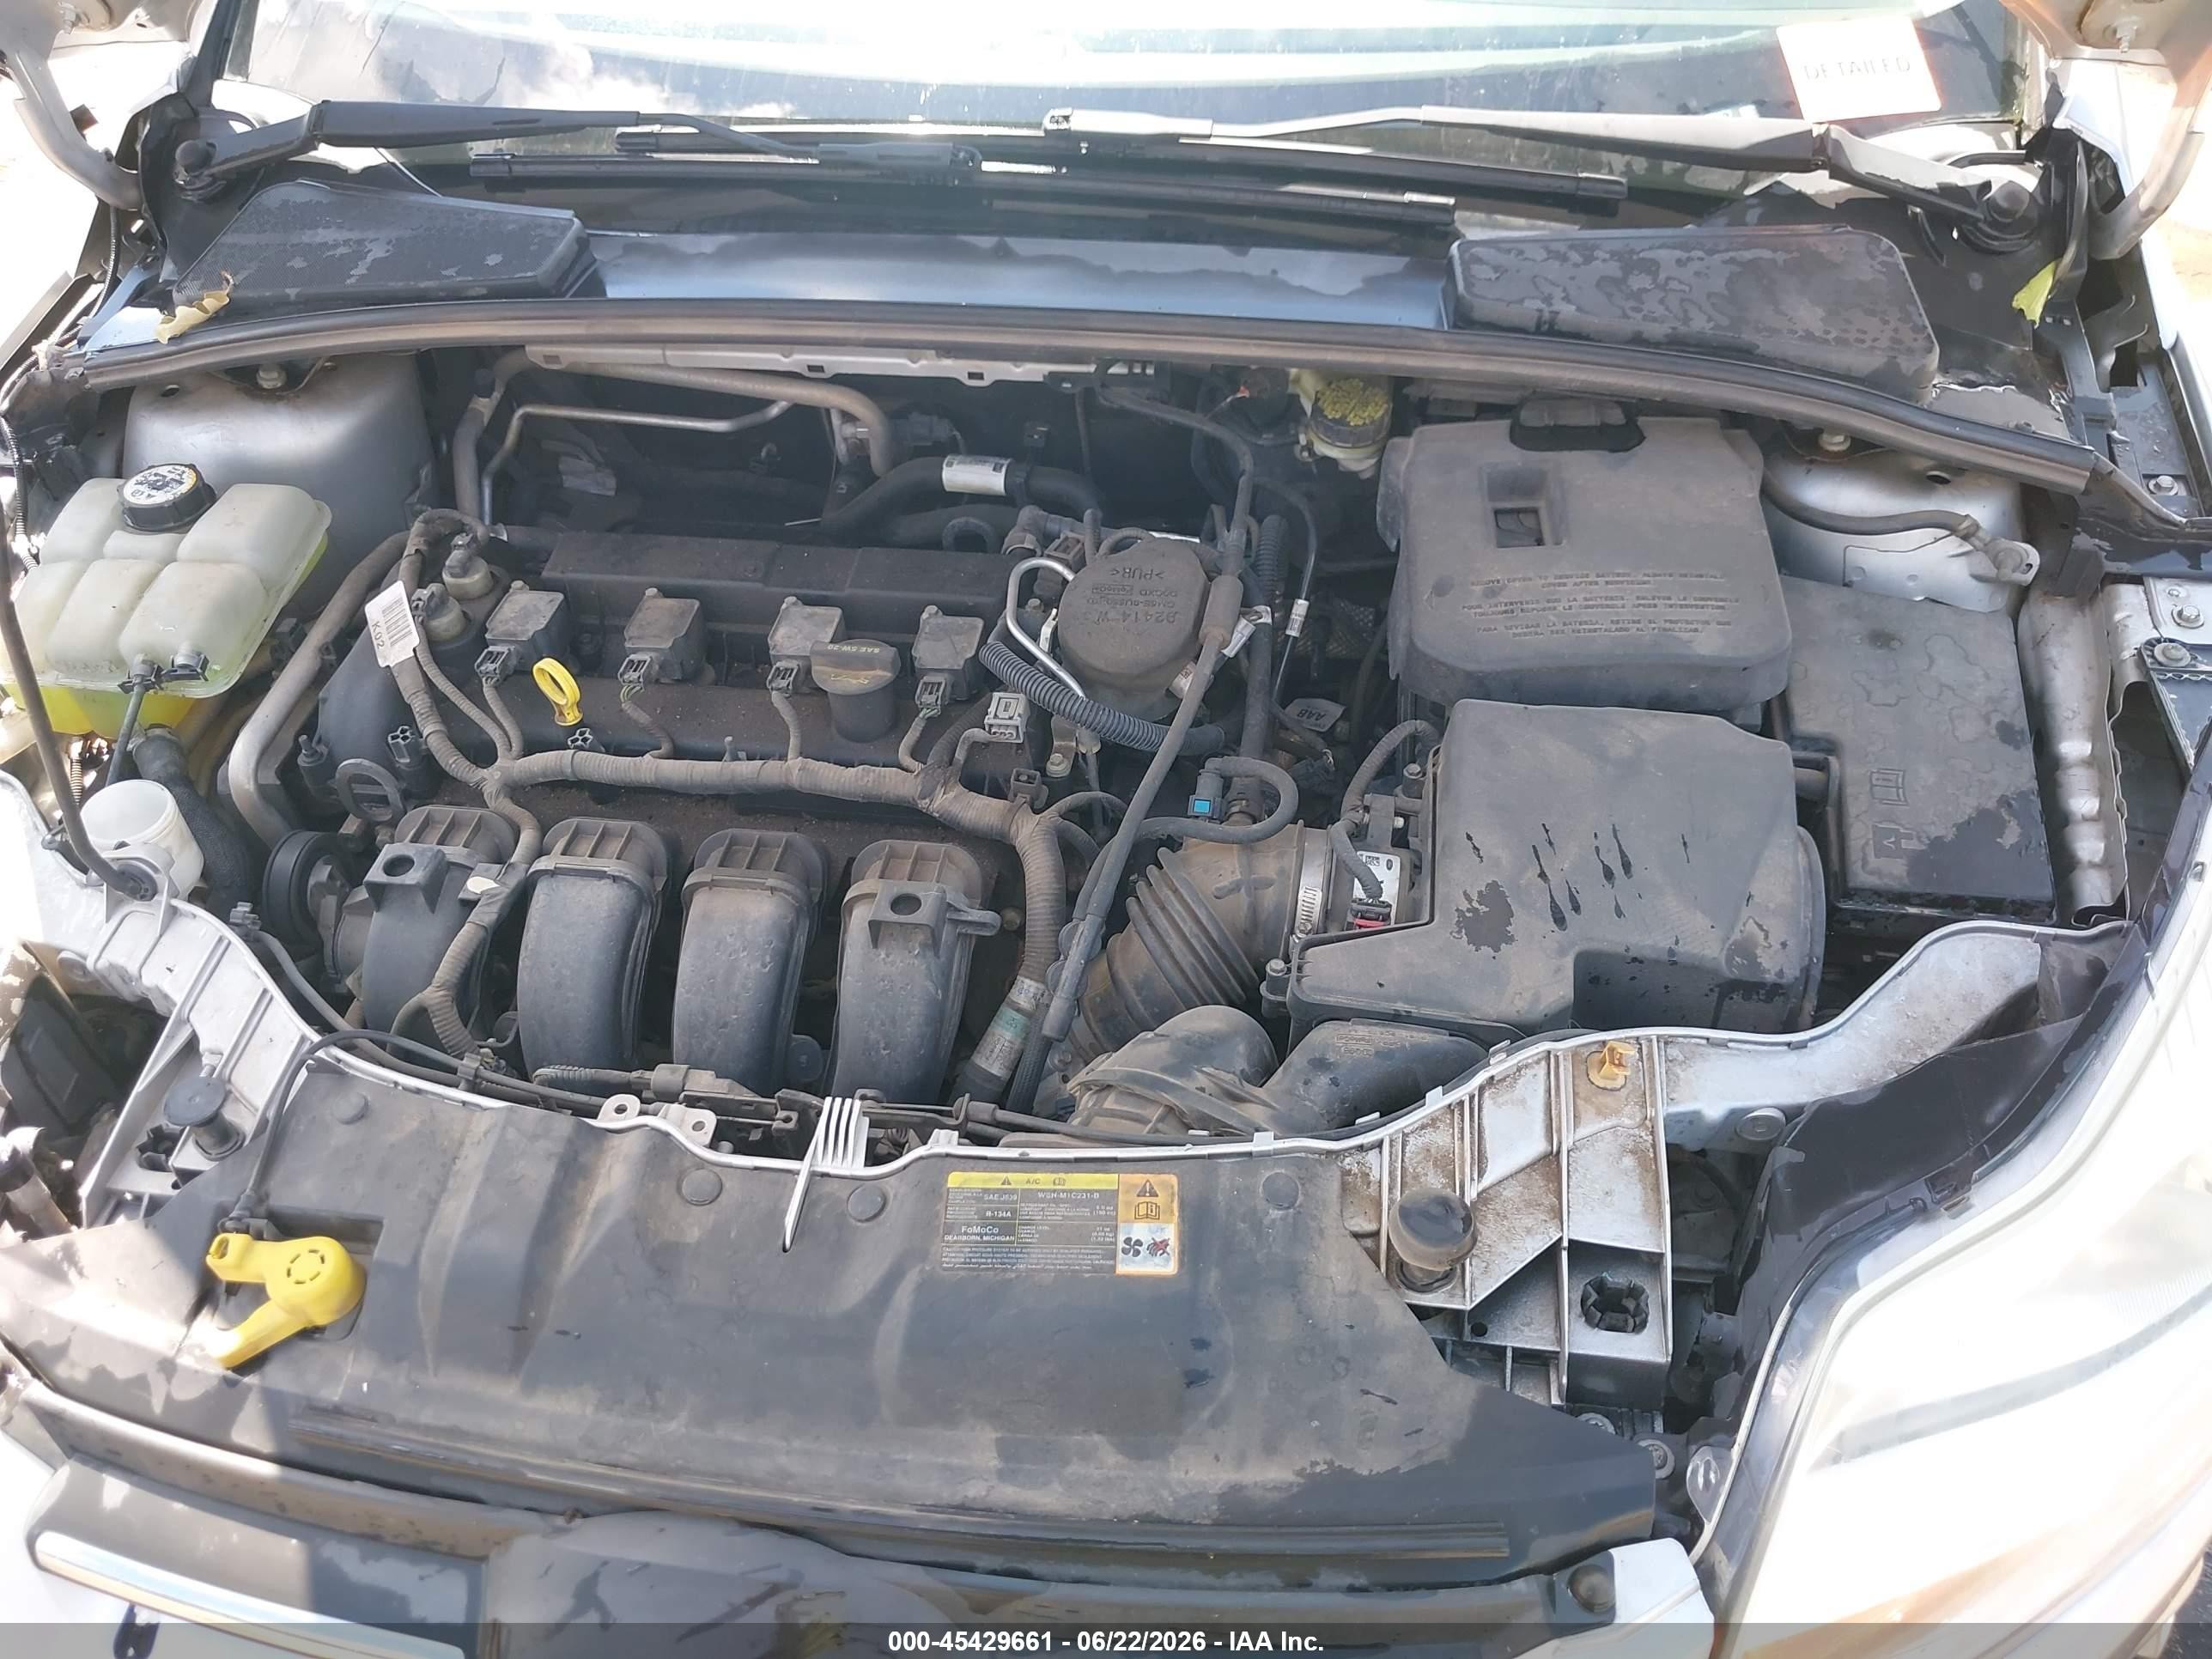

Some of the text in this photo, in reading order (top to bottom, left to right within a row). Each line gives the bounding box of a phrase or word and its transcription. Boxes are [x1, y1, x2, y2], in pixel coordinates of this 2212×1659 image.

[1803, 56, 1911, 80] DETAILED
[371, 621, 386, 649] K02
[827, 644, 858, 653] 5W-20
[1025, 1176, 1041, 1186] A/C
[961, 1225, 1000, 1234] FoMoCo
